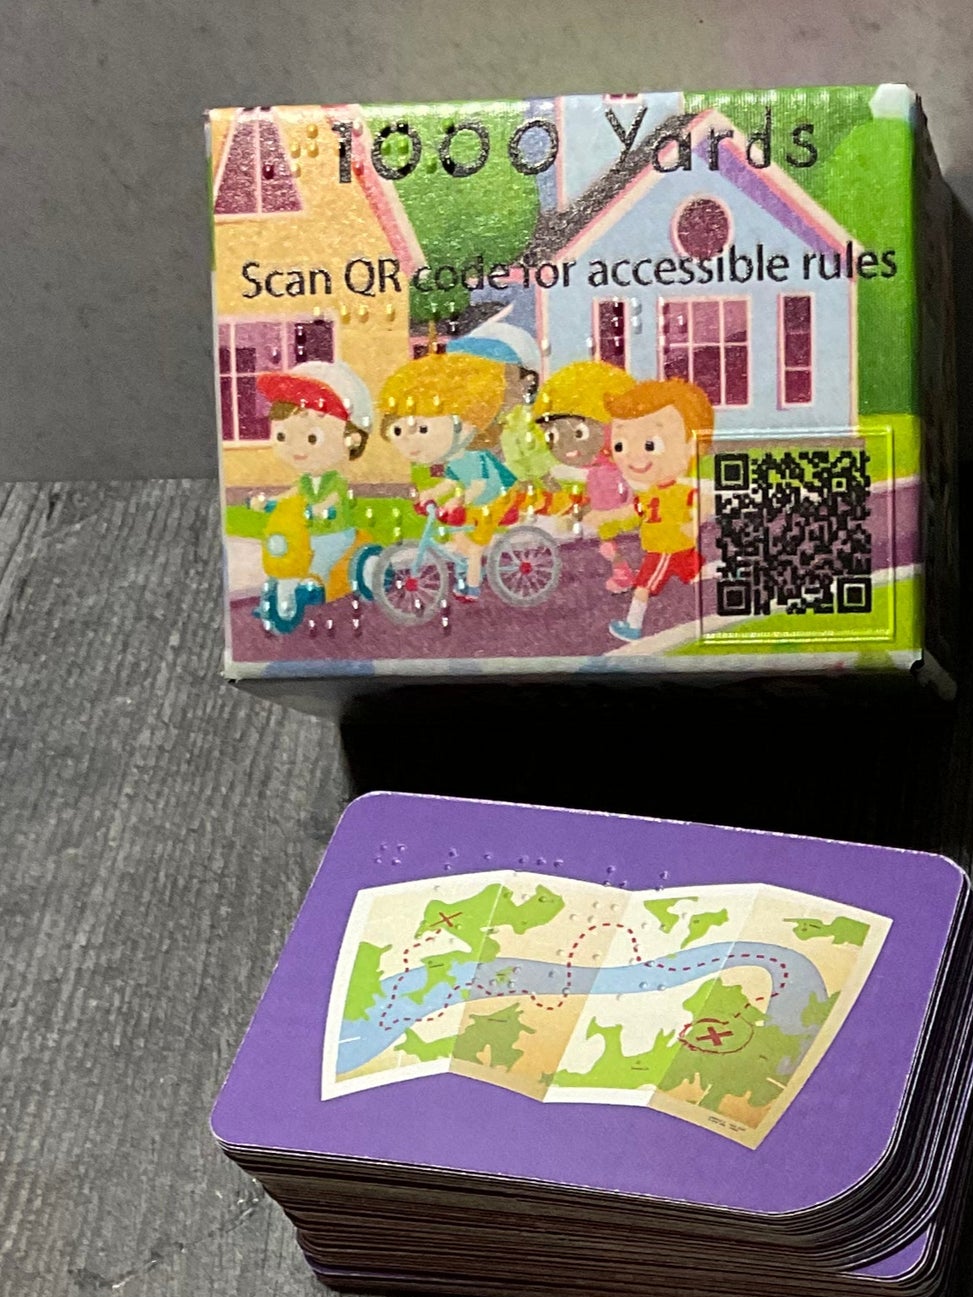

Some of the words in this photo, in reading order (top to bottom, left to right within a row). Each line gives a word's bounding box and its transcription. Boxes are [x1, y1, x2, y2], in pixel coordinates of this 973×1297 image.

[335, 118, 559, 183] 1000
[605, 105, 819, 174] Yards
[242, 261, 332, 298] Scan
[344, 256, 402, 297] QR
[413, 255, 510, 292] code
[519, 256, 576, 288] for
[587, 243, 790, 287] accessible
[802, 240, 897, 279] rules
